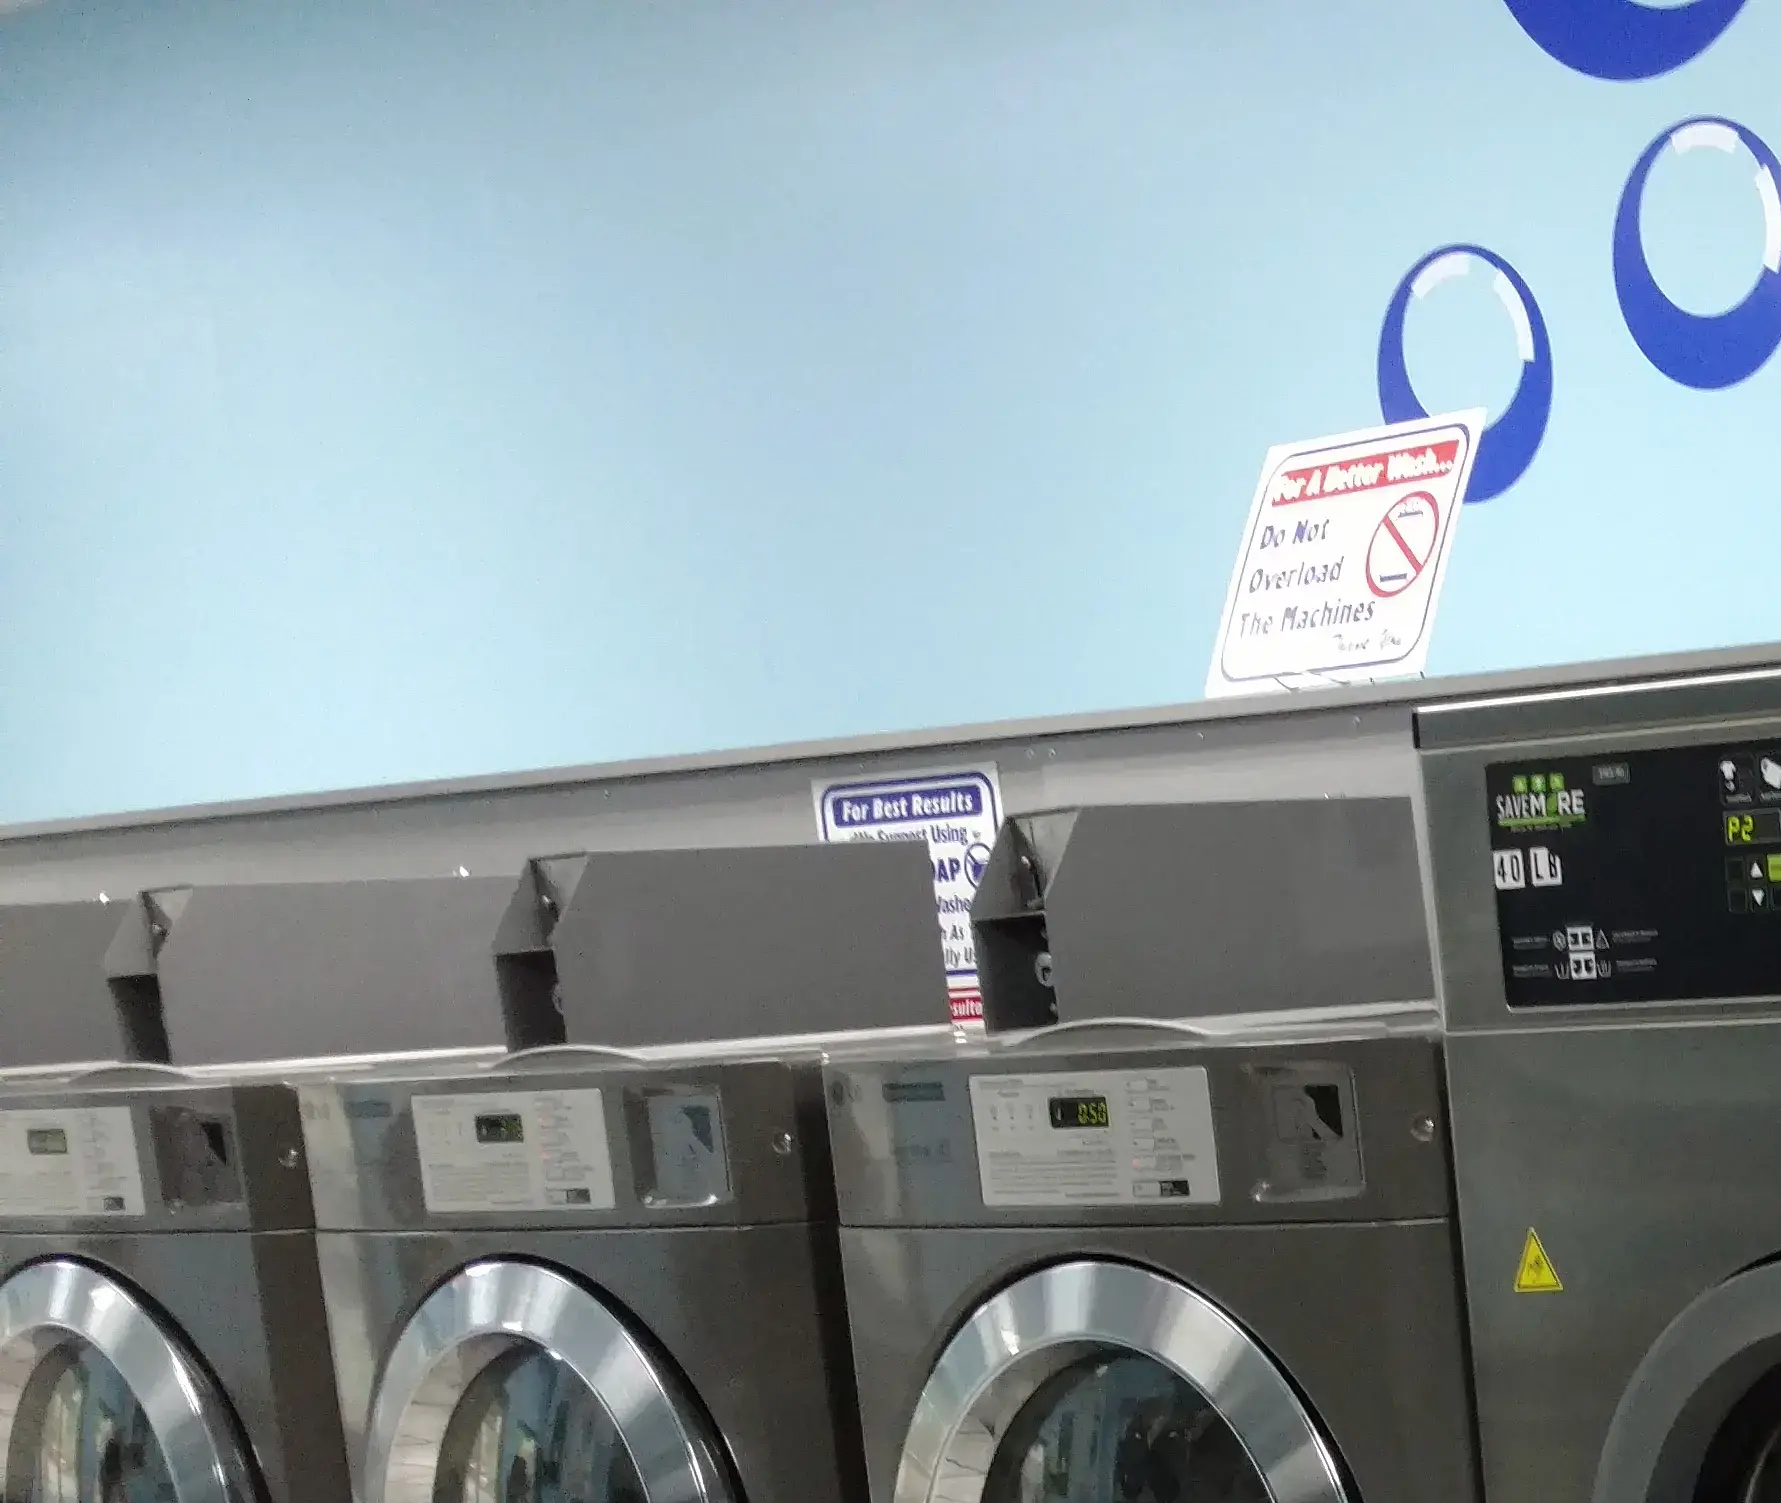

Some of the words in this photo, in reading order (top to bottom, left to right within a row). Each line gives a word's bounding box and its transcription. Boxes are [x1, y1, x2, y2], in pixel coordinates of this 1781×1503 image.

[1260, 525, 1286, 549] Do
[1292, 518, 1329, 544] Not
[1249, 555, 1344, 593] Overload
[1241, 611, 1273, 638] The
[1280, 598, 1376, 632] Machines
[841, 800, 869, 822] For
[872, 796, 908, 820] Best
[912, 790, 973, 817] Results
[930, 823, 969, 846] Using
[1498, 854, 1519, 882] 40
